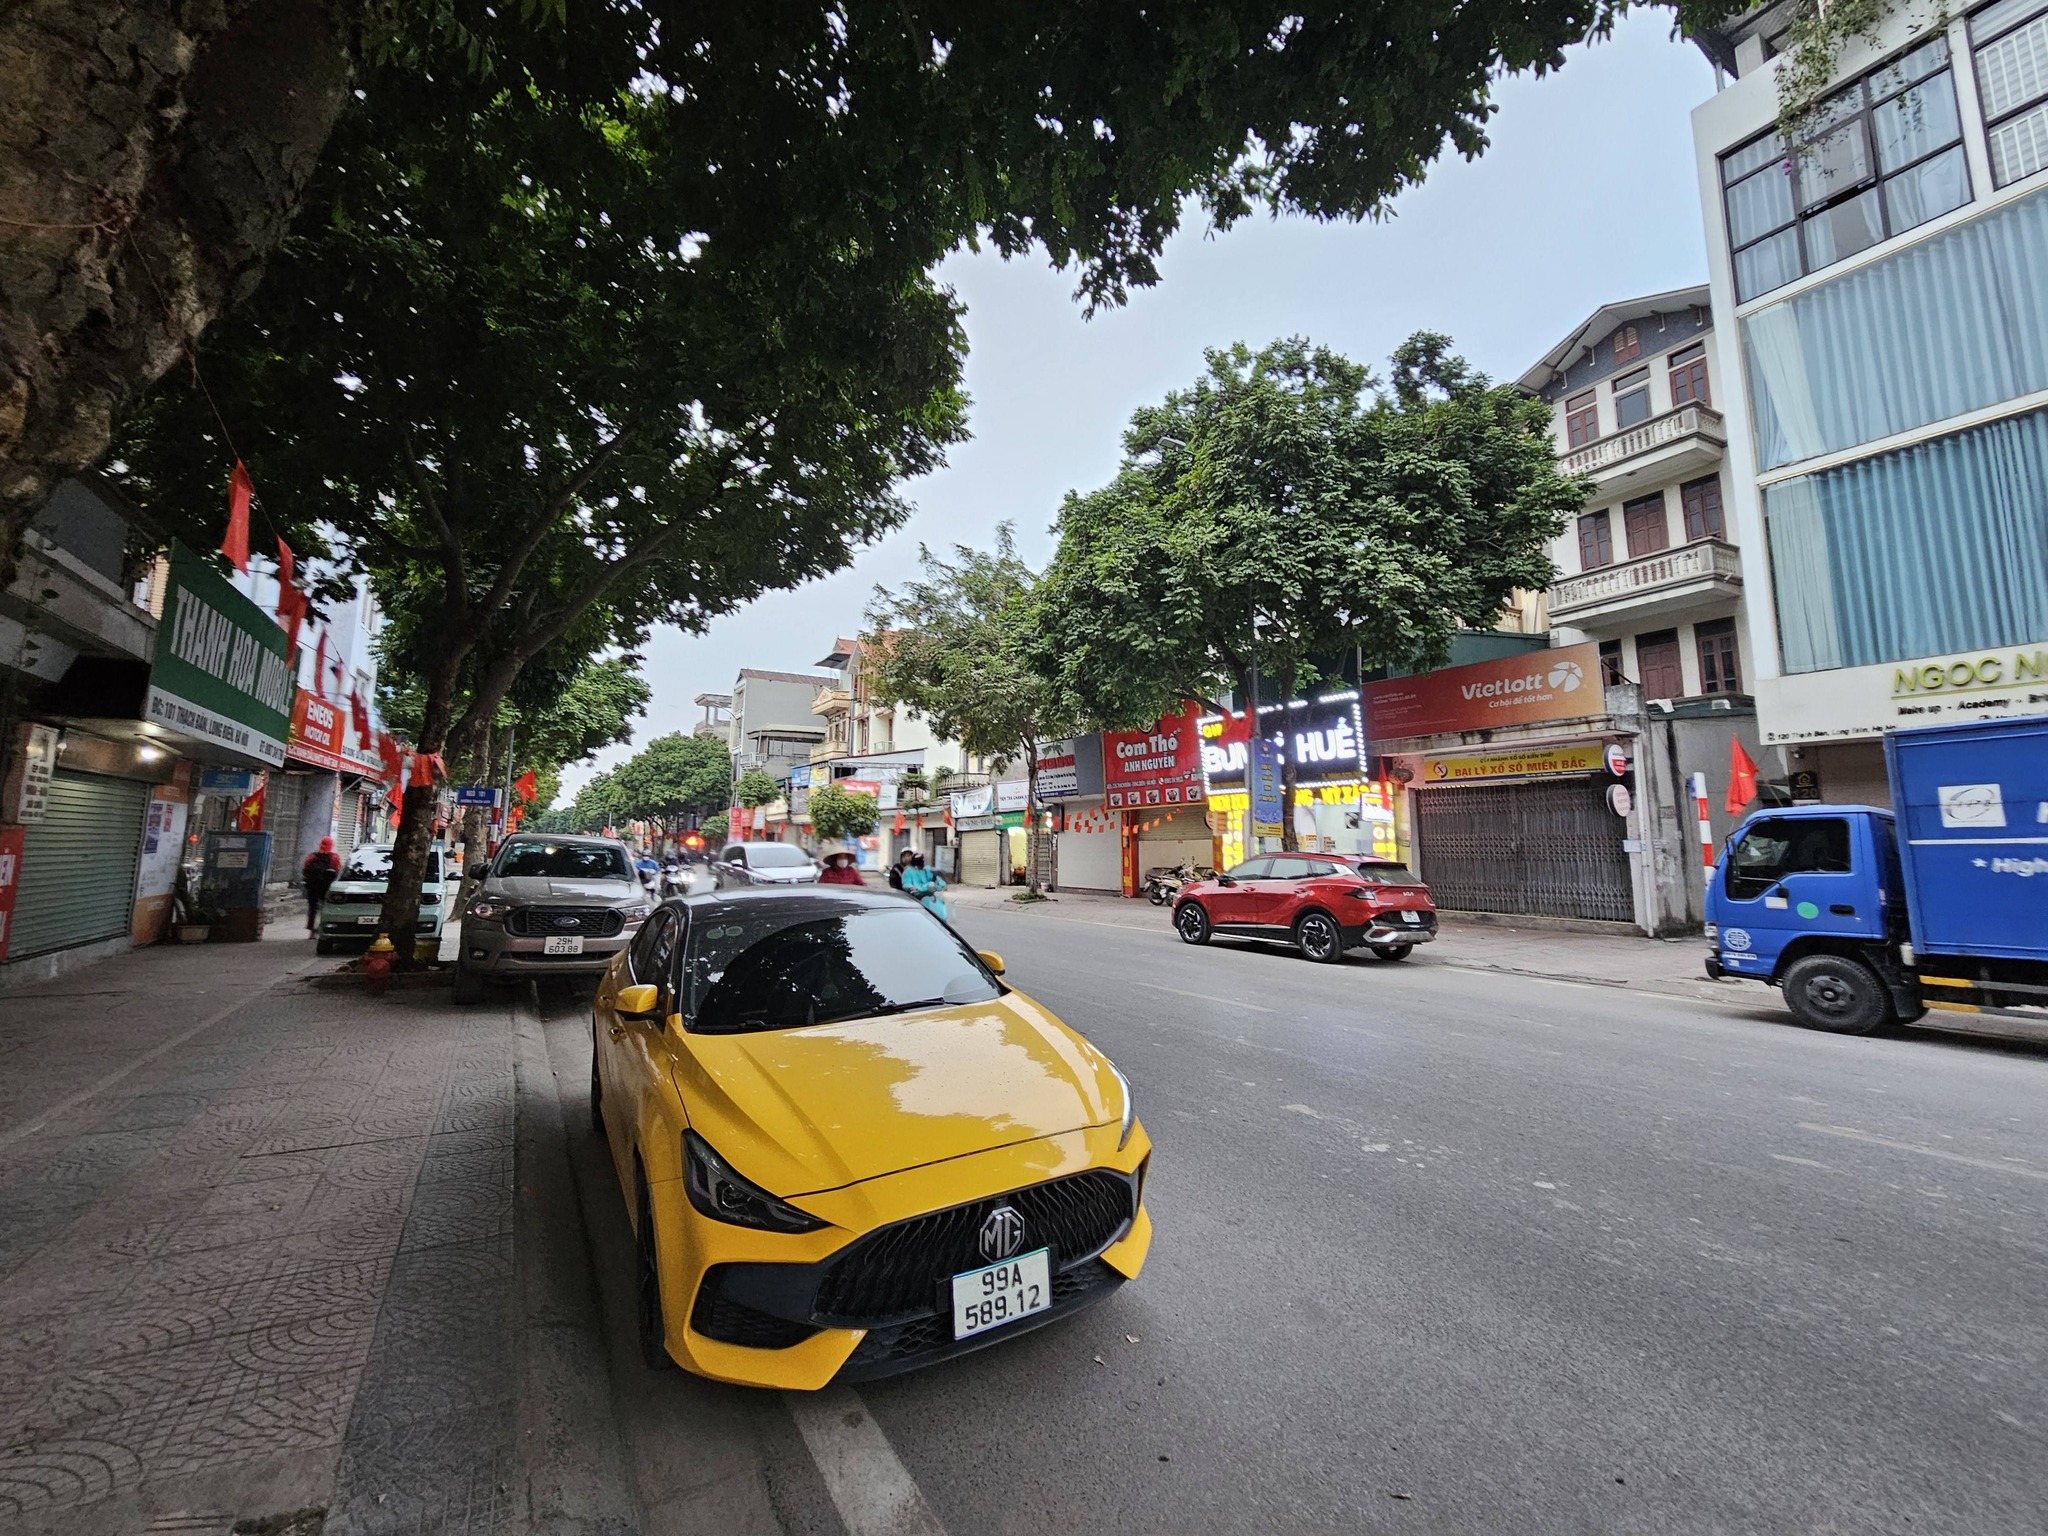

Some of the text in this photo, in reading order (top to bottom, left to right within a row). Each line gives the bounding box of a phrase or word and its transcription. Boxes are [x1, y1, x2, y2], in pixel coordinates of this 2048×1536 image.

[170, 584, 296, 718] THANH HOA MOBILE
[1461, 673, 1543, 700] Vietlott
[1893, 657, 2001, 692] NGOC
[306, 699, 334, 730] ENEOS
[1500, 698, 1512, 708] hội
[1957, 698, 2011, 709] Academy
[304, 724, 322, 743] MOTOR
[1295, 716, 1357, 763] HUẾ
[1124, 760, 1140, 773] ANH
[1455, 767, 1472, 778] ĐẠI
[1490, 761, 1505, 774] XỔ
[1508, 760, 1523, 773] SỐ
[1561, 756, 1586, 769] BẮC
[556, 937, 573, 945] 29H
[984, 1211, 1021, 1259] MG
[982, 1262, 1023, 1296] 99A
[965, 1284, 1040, 1330] 589.12
